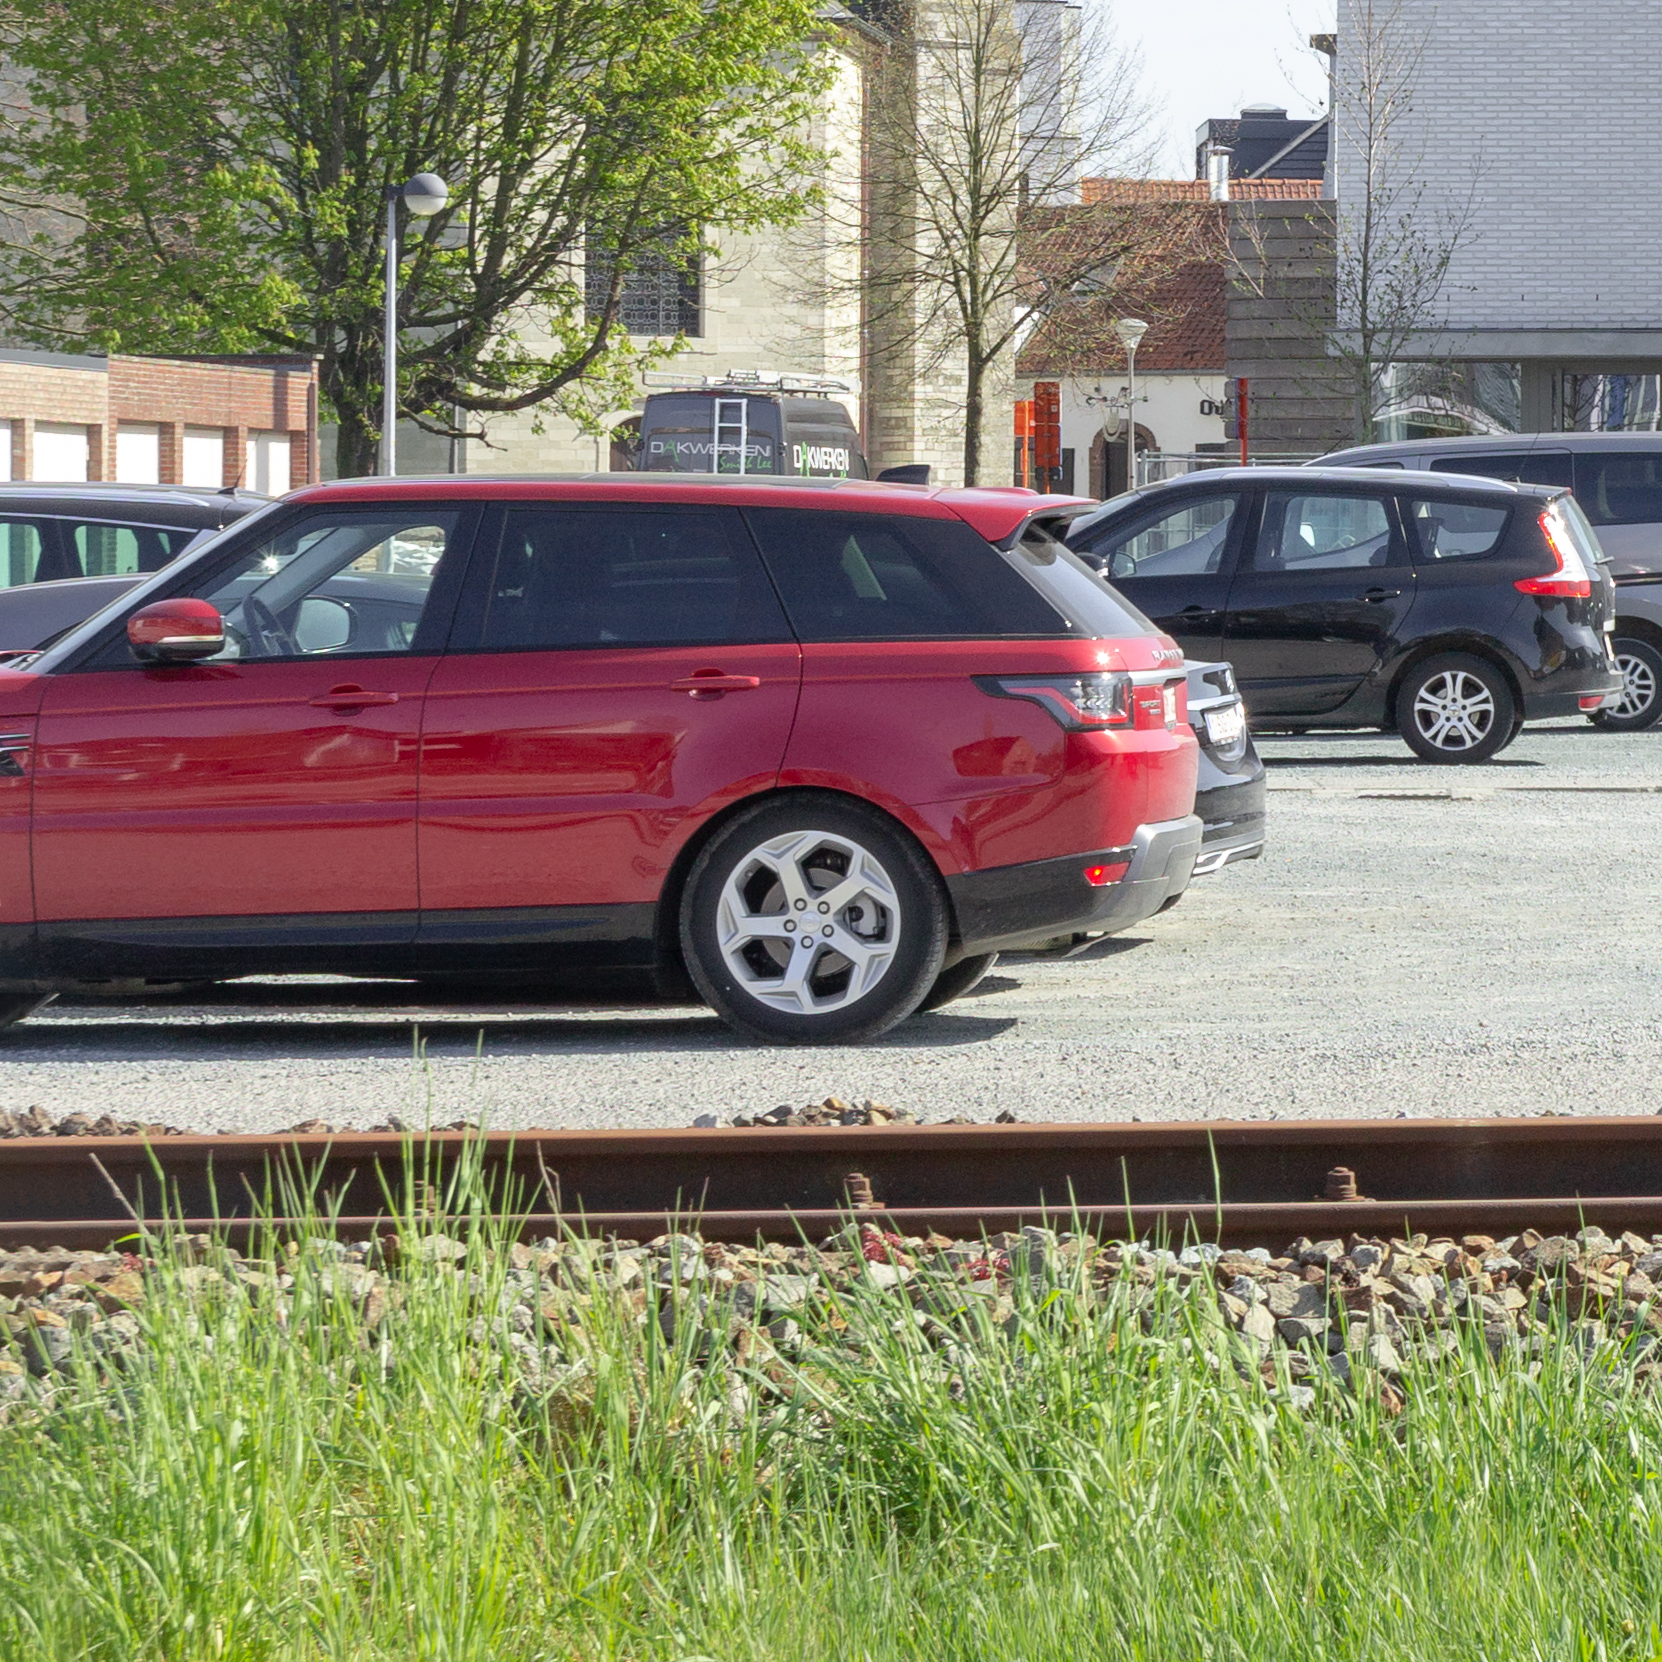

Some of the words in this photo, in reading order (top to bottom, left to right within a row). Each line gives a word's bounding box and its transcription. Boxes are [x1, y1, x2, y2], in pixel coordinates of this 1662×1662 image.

[650, 440, 771, 463] DAKWERKEN
[719, 455, 753, 471] Smih
[793, 441, 849, 478] DAKWERKEN
